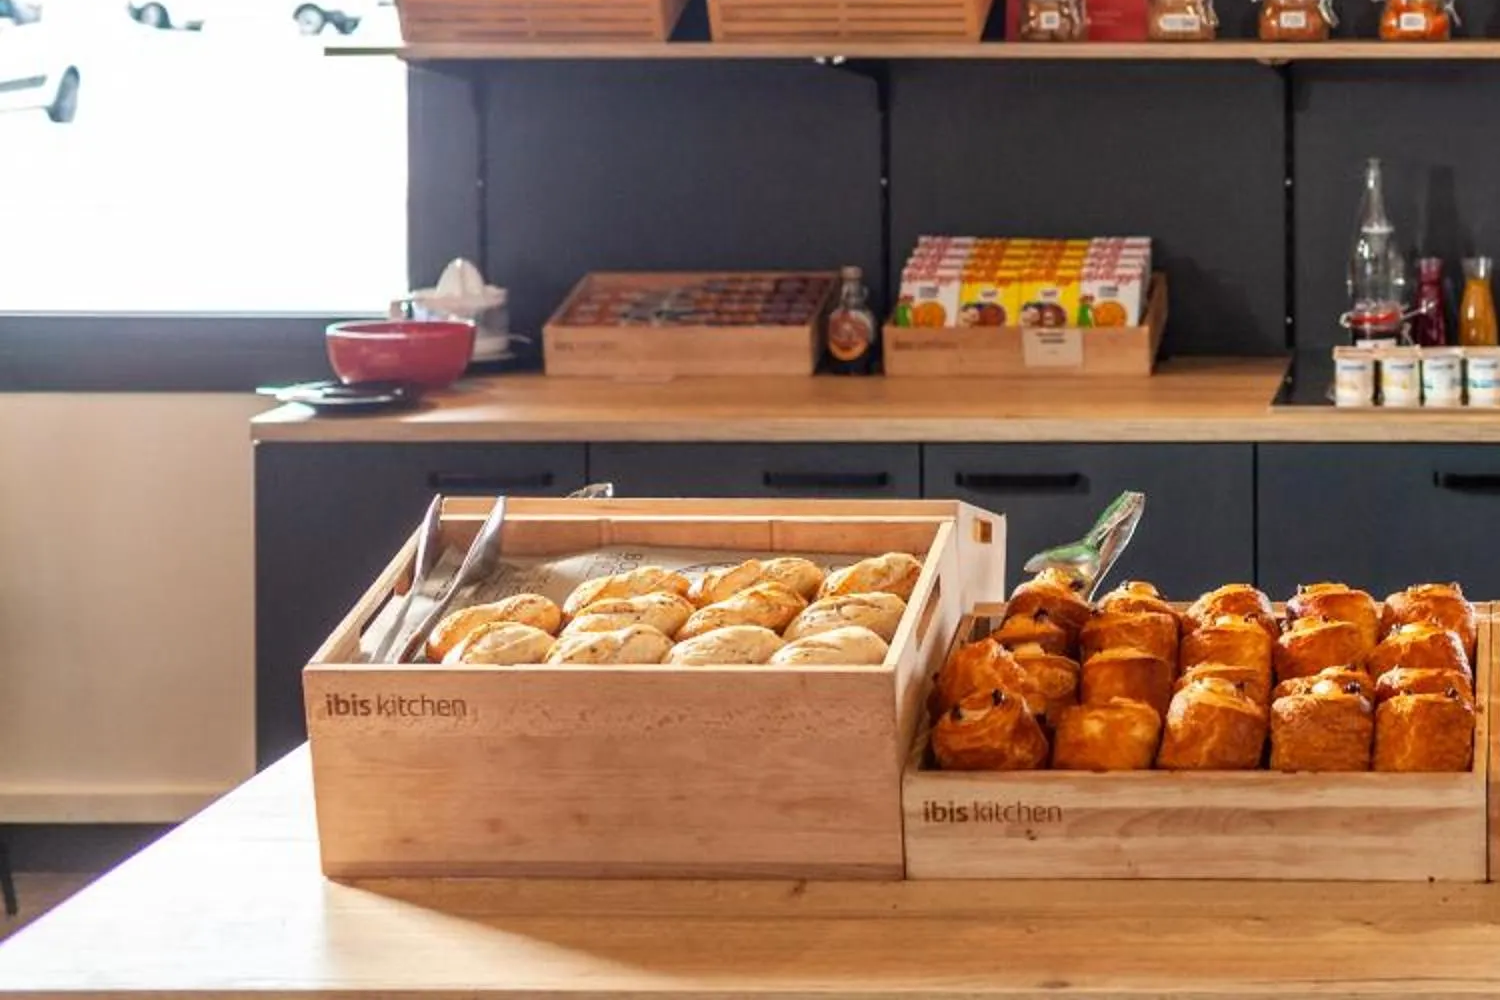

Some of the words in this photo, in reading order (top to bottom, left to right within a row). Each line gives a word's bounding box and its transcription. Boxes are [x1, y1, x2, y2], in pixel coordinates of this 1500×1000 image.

[325, 693, 372, 717] ibis
[376, 693, 467, 717] kitchen
[923, 801, 969, 823] ibis
[973, 801, 1062, 823] kitchen
